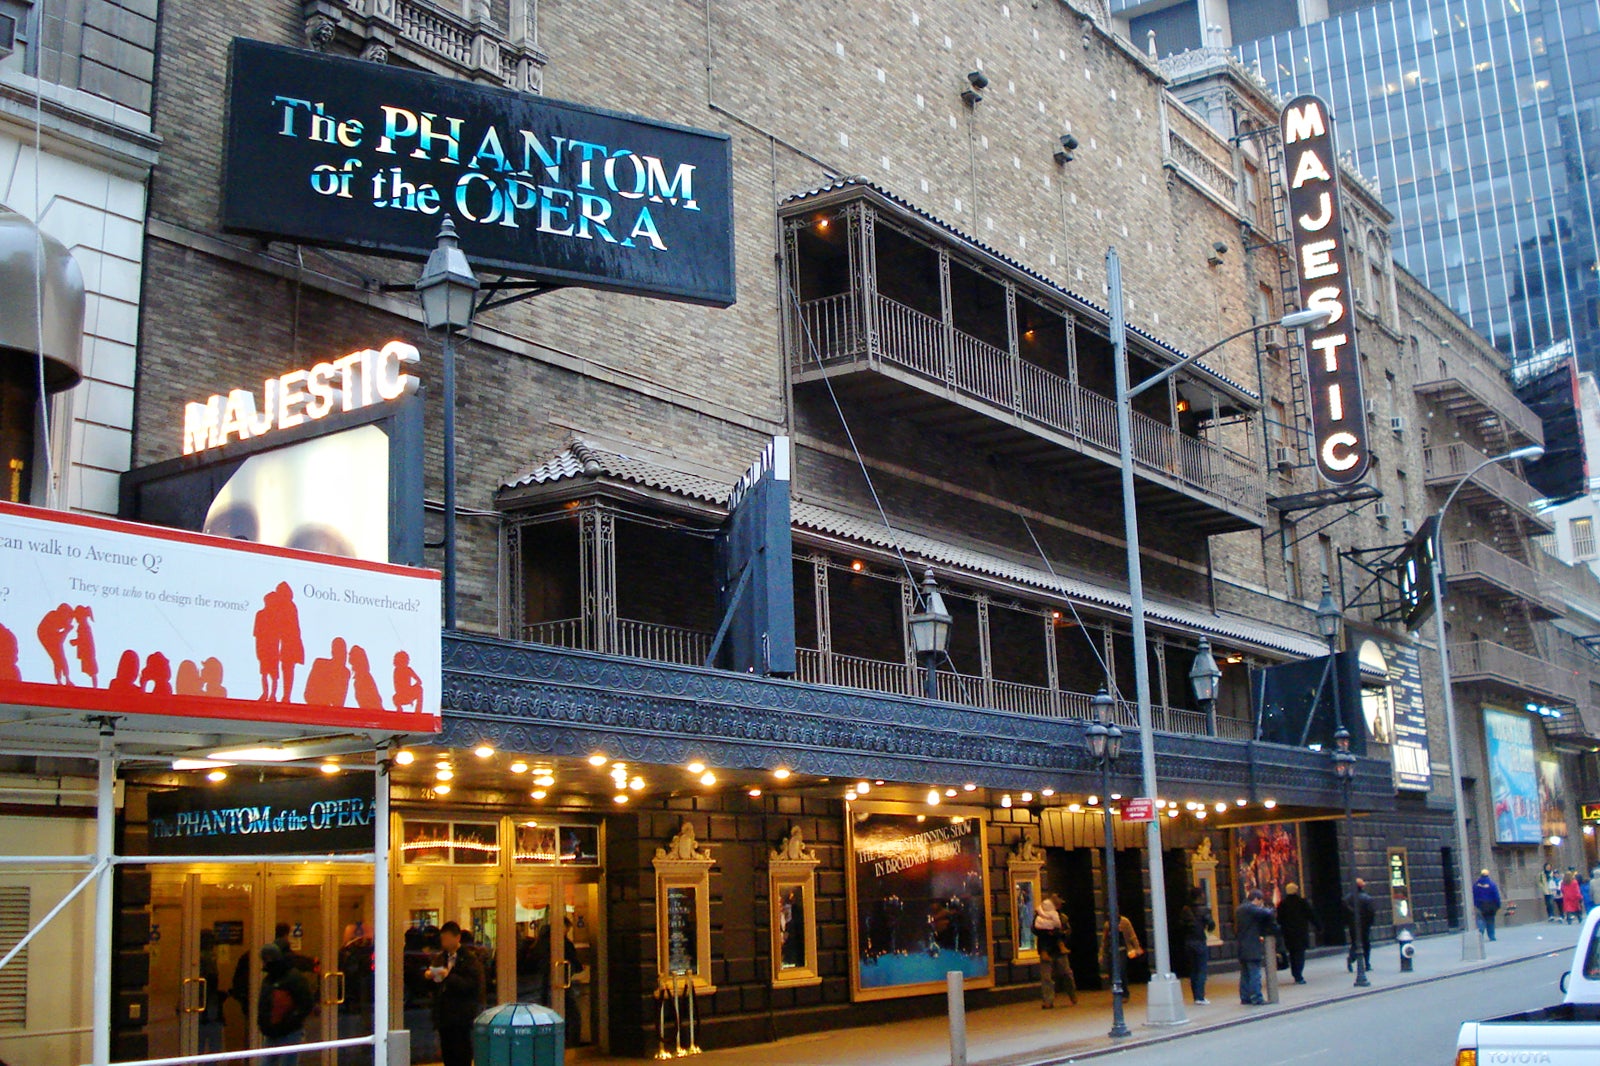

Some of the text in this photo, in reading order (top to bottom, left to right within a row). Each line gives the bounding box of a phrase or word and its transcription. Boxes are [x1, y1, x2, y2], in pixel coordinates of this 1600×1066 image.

[271, 95, 700, 212] The PHANTOM
[310, 158, 668, 252] of the OPERA
[1285, 102, 1360, 472] MAJESTIC
[183, 340, 420, 455] MAJESTIC
[28, 538, 62, 555] walk
[67, 545, 82, 558] to
[85, 545, 138, 567] Avenue
[142, 552, 163, 574] Q?
[69, 576, 250, 612] They got who to design the rooms?
[303, 583, 421, 613] Oooh. Showerheads?
[176, 806, 271, 838] PHANTOM
[273, 811, 286, 833] of
[287, 809, 308, 832] the
[950, 820, 971, 838] SHOW
[875, 860, 885, 877] IN
[886, 851, 928, 874] BROADWAY
[1488, 1051, 1551, 1064] TOYOTA
